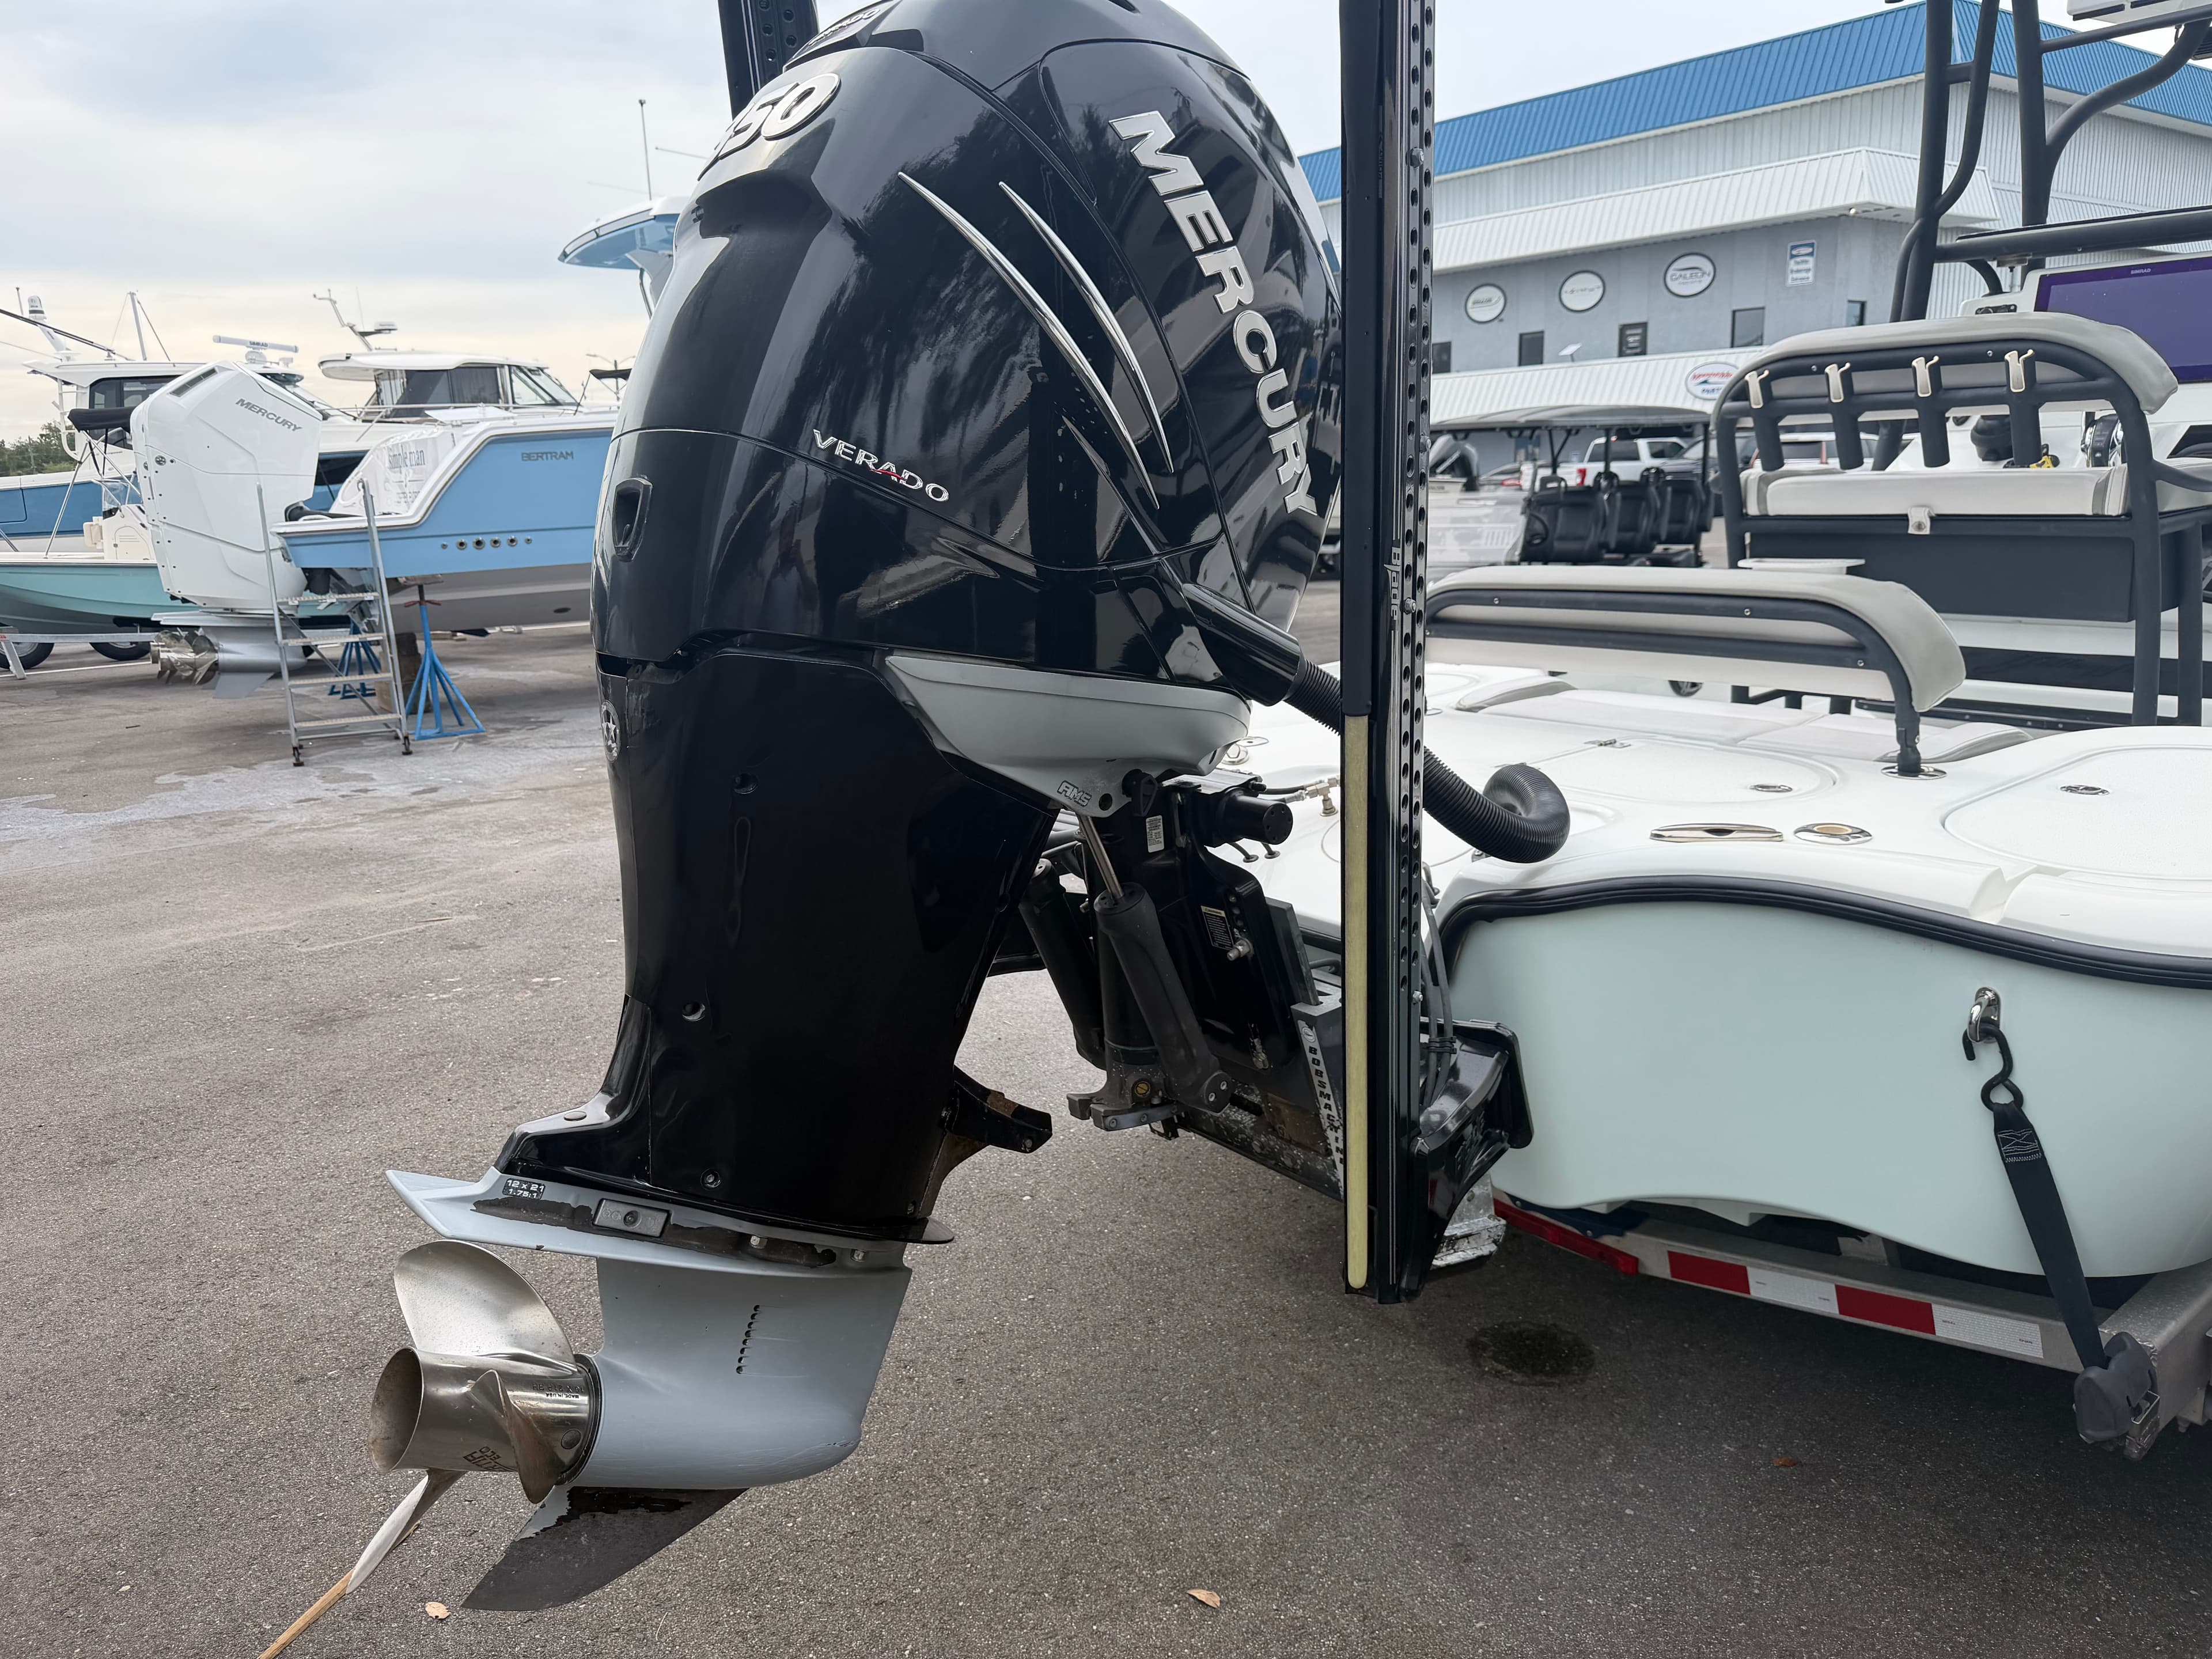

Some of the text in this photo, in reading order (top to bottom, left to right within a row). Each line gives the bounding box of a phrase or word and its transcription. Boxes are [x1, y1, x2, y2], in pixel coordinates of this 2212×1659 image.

[1108, 109, 1317, 516] MERCURY
[236, 398, 302, 431] MERCURY
[521, 450, 574, 462] BERTRAM
[813, 429, 949, 502] VERADO
[507, 1180, 520, 1188] 12
[530, 1184, 544, 1192] 21
[509, 1188, 537, 1199] 1.75:1
